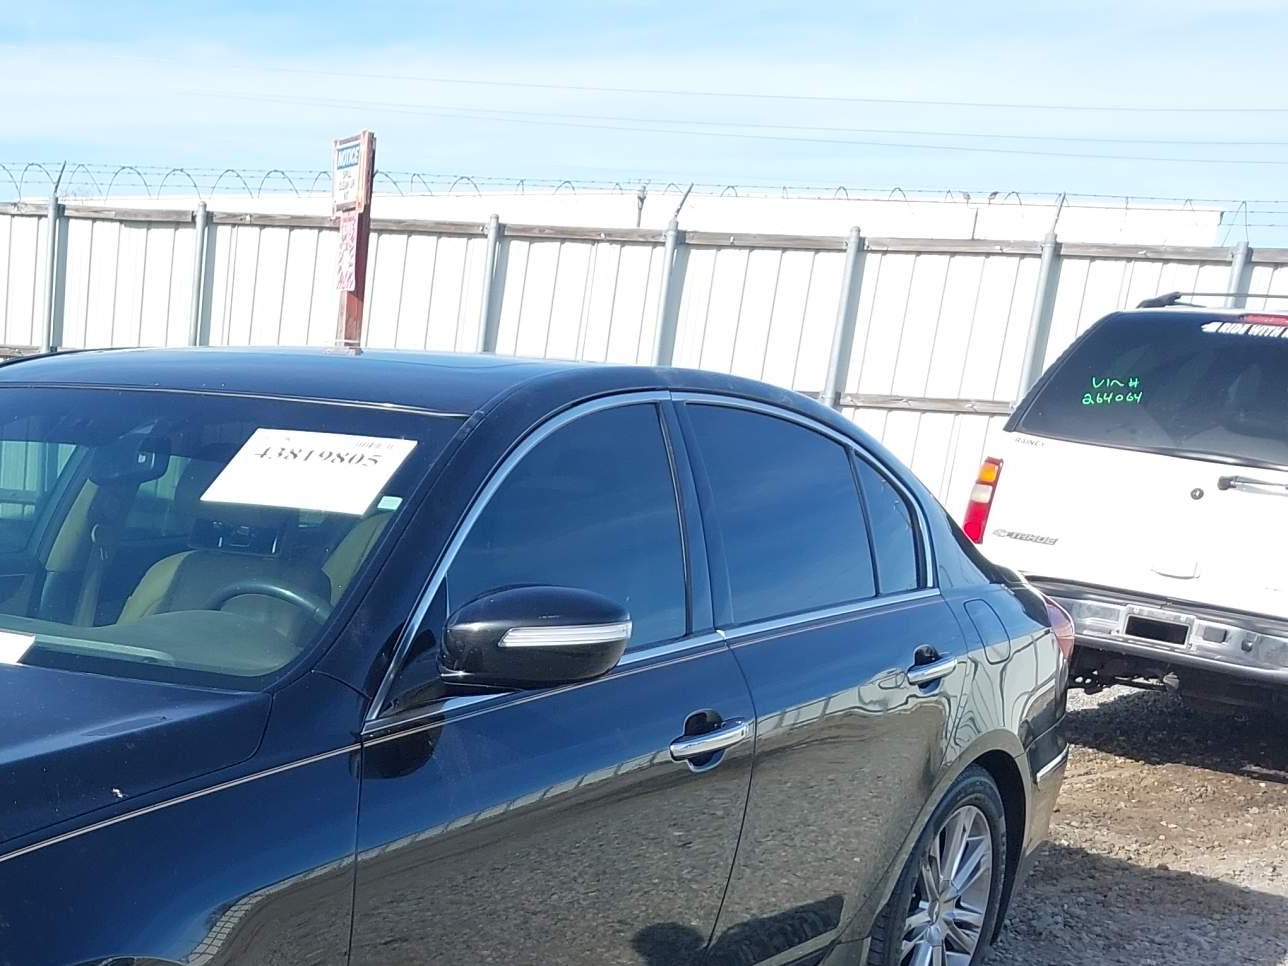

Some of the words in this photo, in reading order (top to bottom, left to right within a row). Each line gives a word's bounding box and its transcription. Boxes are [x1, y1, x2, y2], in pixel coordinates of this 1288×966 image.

[337, 147, 360, 167] NOTICE
[1218, 322, 1252, 335] RIDE
[1248, 325, 1285, 337] WITH
[1092, 376, 1124, 389] VIN
[1082, 391, 1143, 405] 264064
[254, 445, 384, 468] 43819805
